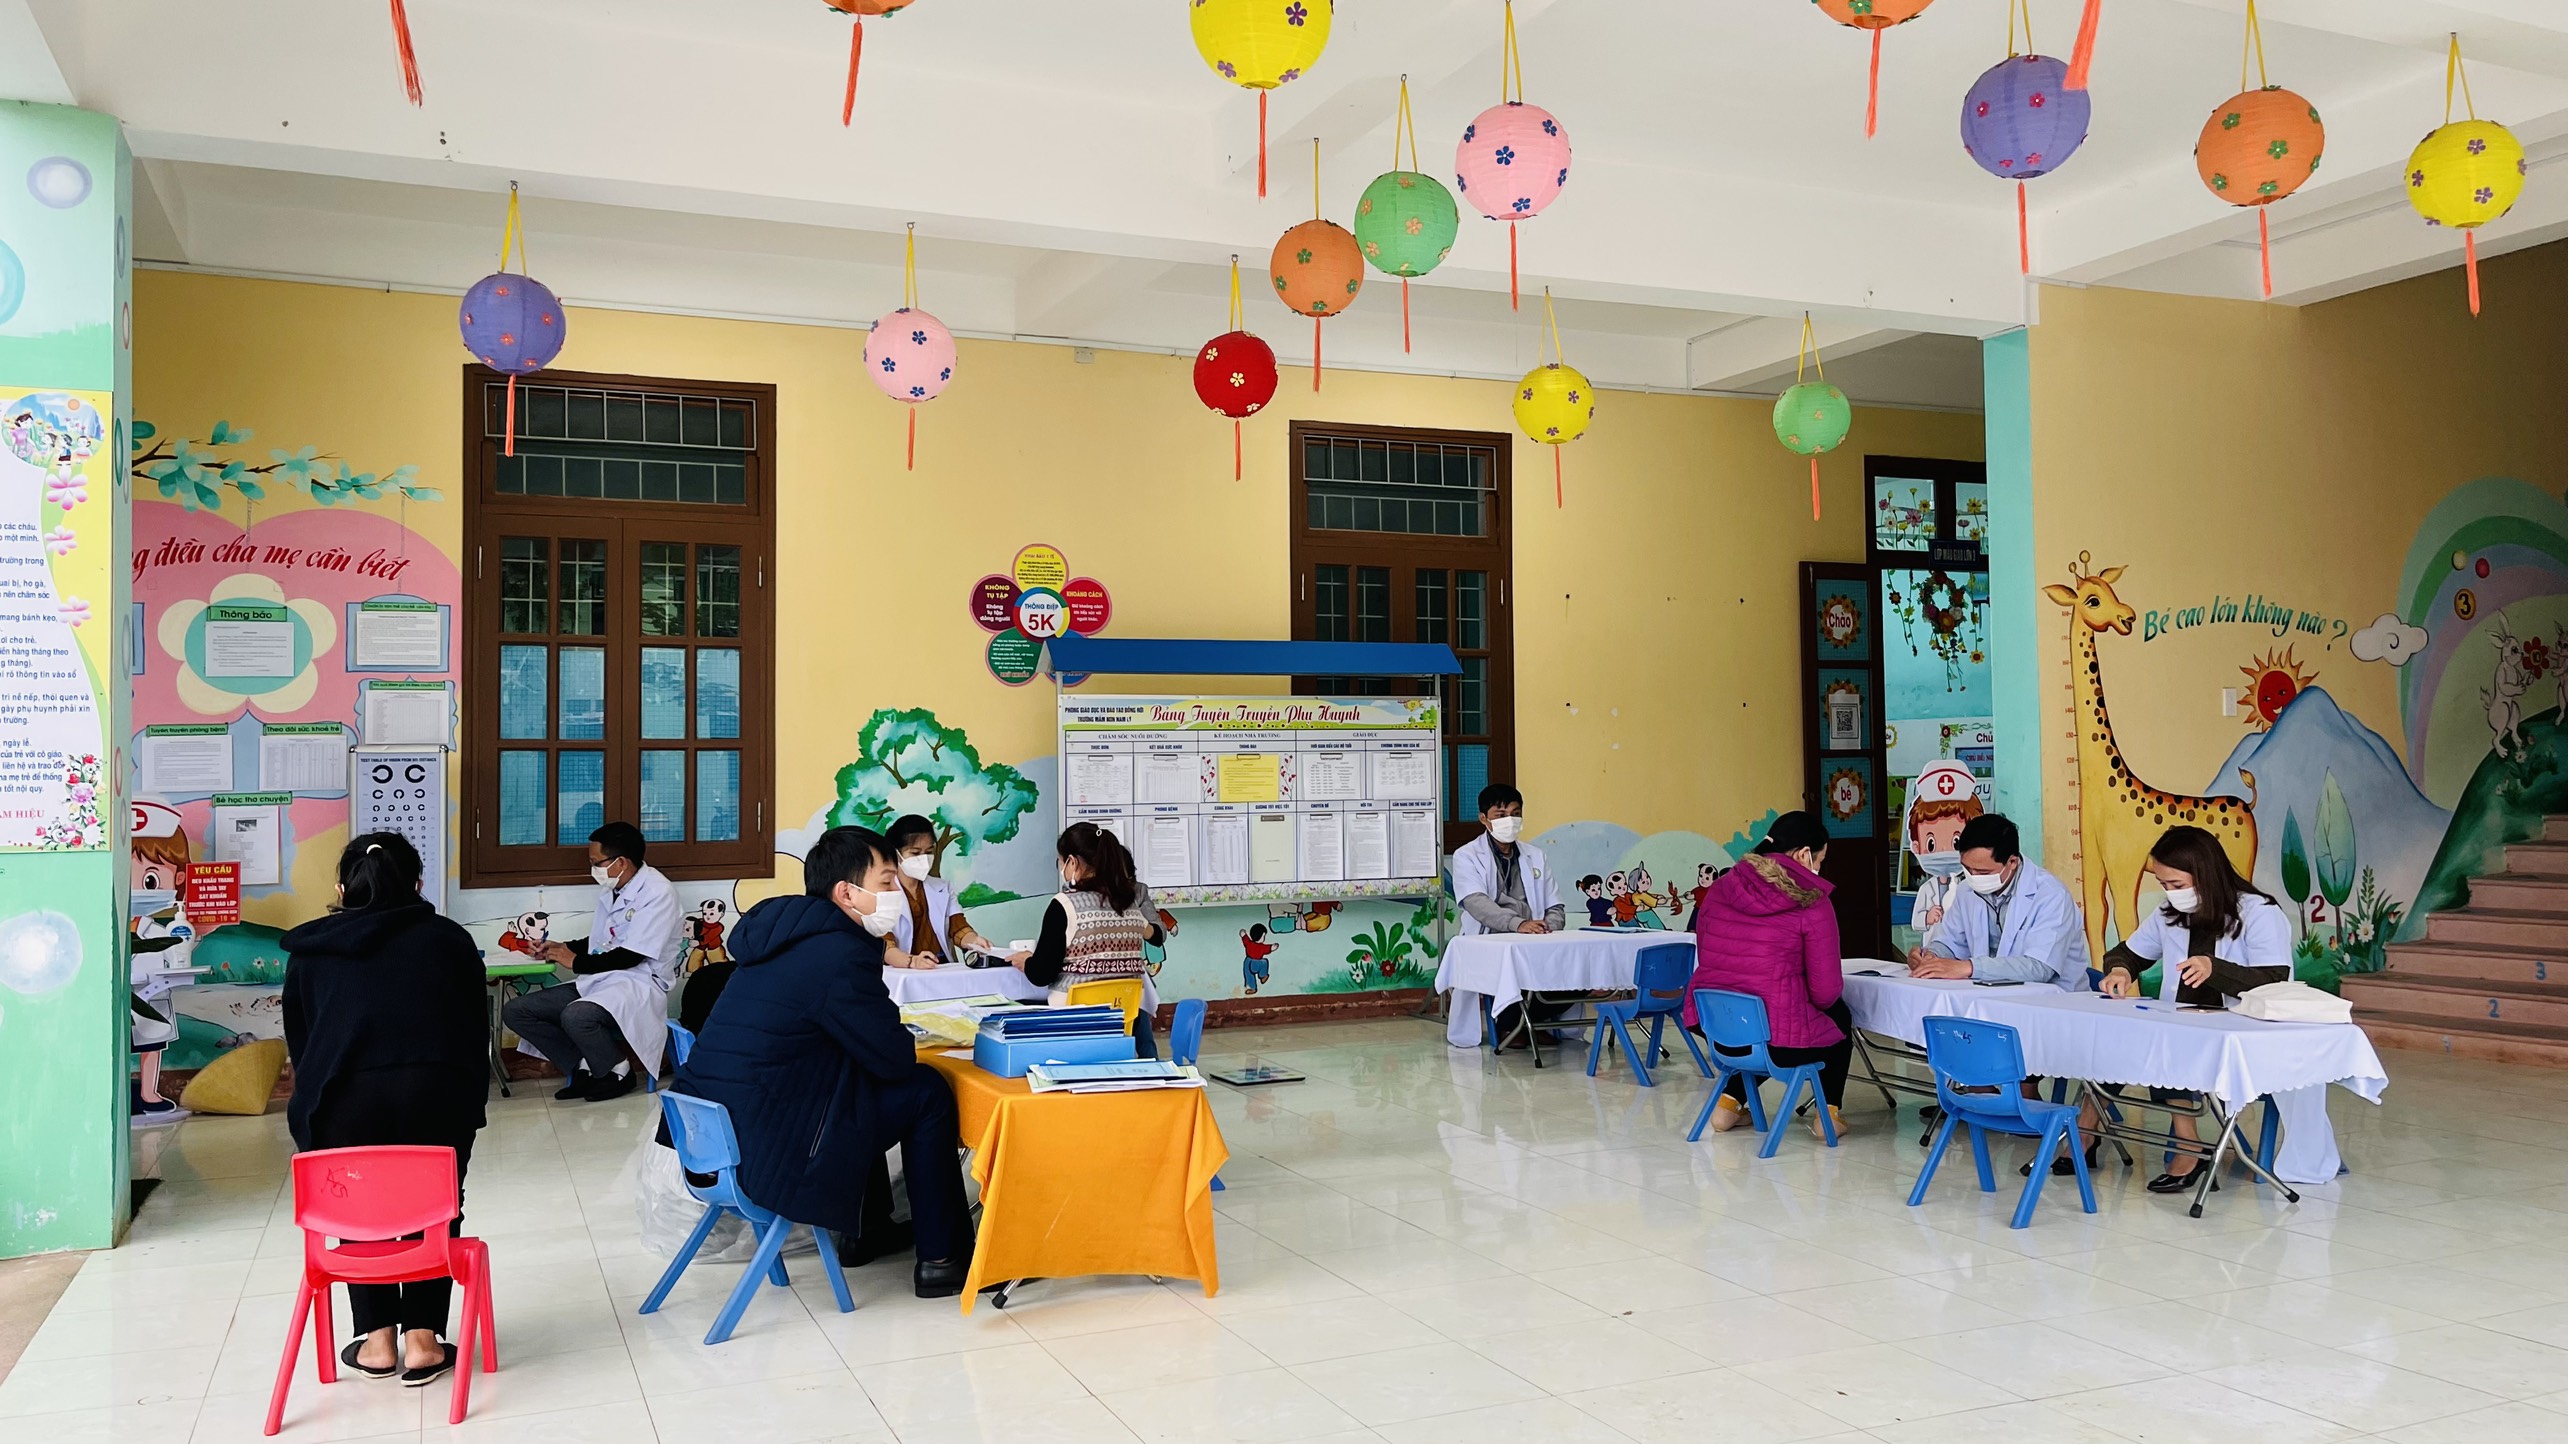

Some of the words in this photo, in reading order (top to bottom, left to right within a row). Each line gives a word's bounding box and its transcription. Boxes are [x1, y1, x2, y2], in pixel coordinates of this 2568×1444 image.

[25, 557, 44, 566] trong
[154, 537, 206, 567] điều
[212, 534, 258, 562] cha
[263, 546, 302, 569] mẹ
[306, 547, 352, 572] cần
[356, 548, 411, 580] biết
[1046, 603, 1059, 611] ĐIỆP
[2459, 593, 2471, 615] 3
[220, 610, 250, 620] Thông
[1028, 614, 1055, 631] 5K
[1828, 612, 1851, 628] Chào
[2144, 607, 2170, 642] Bé
[2176, 605, 2205, 630] cao
[2210, 595, 2239, 624] lớn
[2242, 594, 2294, 637] không
[2296, 610, 2326, 635] nào
[2327, 620, 2348, 651] ?
[12, 648, 30, 657] hàng
[32, 648, 51, 658] tháng
[34, 705, 57, 714] huynh
[1150, 705, 1186, 724] Bảng
[1191, 705, 1230, 724] Tuyên
[1236, 705, 1280, 724] Truyền
[1285, 705, 1312, 725] Phụ
[1318, 705, 1360, 724] Huynh
[1976, 731, 1993, 742] Chủ
[1840, 786, 1852, 800] bé
[194, 866, 211, 874] YÊU
[2310, 895, 2325, 923] 2
[2535, 961, 2547, 980] 3
[2488, 999, 2499, 1018] 2
